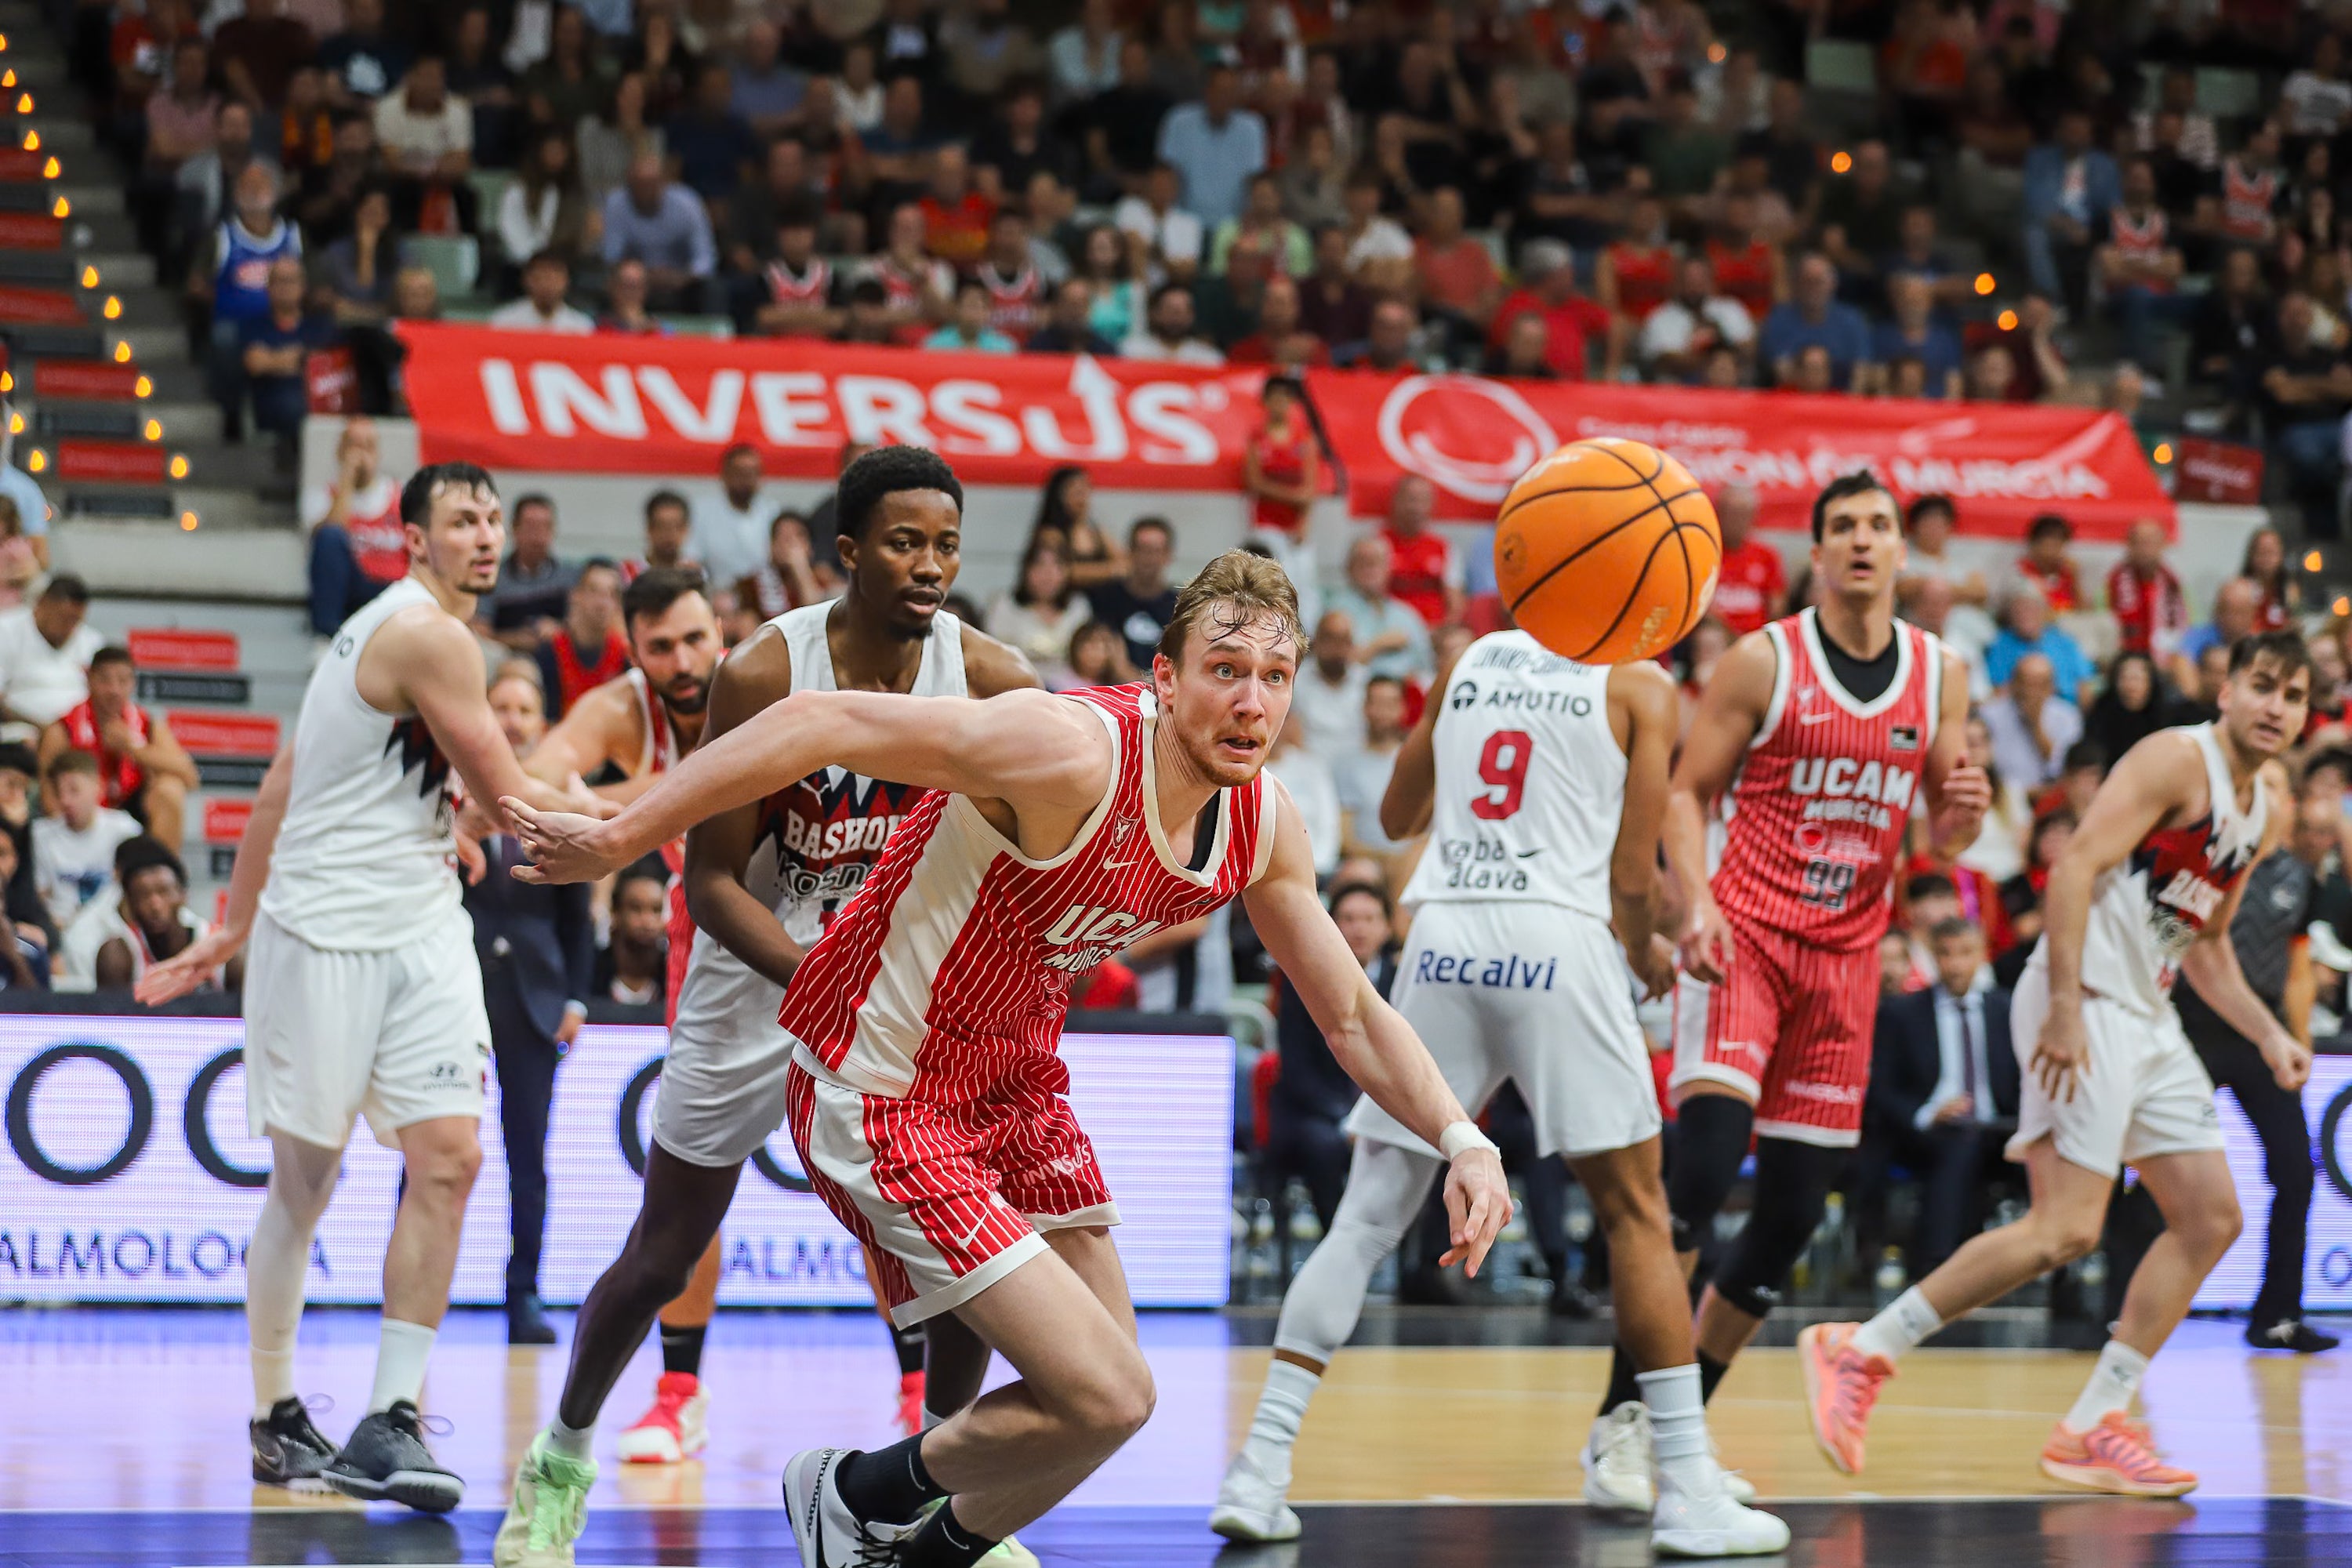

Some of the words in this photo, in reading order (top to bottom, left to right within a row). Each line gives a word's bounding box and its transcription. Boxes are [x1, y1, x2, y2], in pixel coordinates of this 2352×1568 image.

[1485, 689, 1592, 717] AMUTIO
[1470, 730, 1534, 821] 9
[1790, 755, 1915, 811] UCAM
[1802, 859, 1857, 909] 99
[1415, 949, 1558, 992] Recalvi
